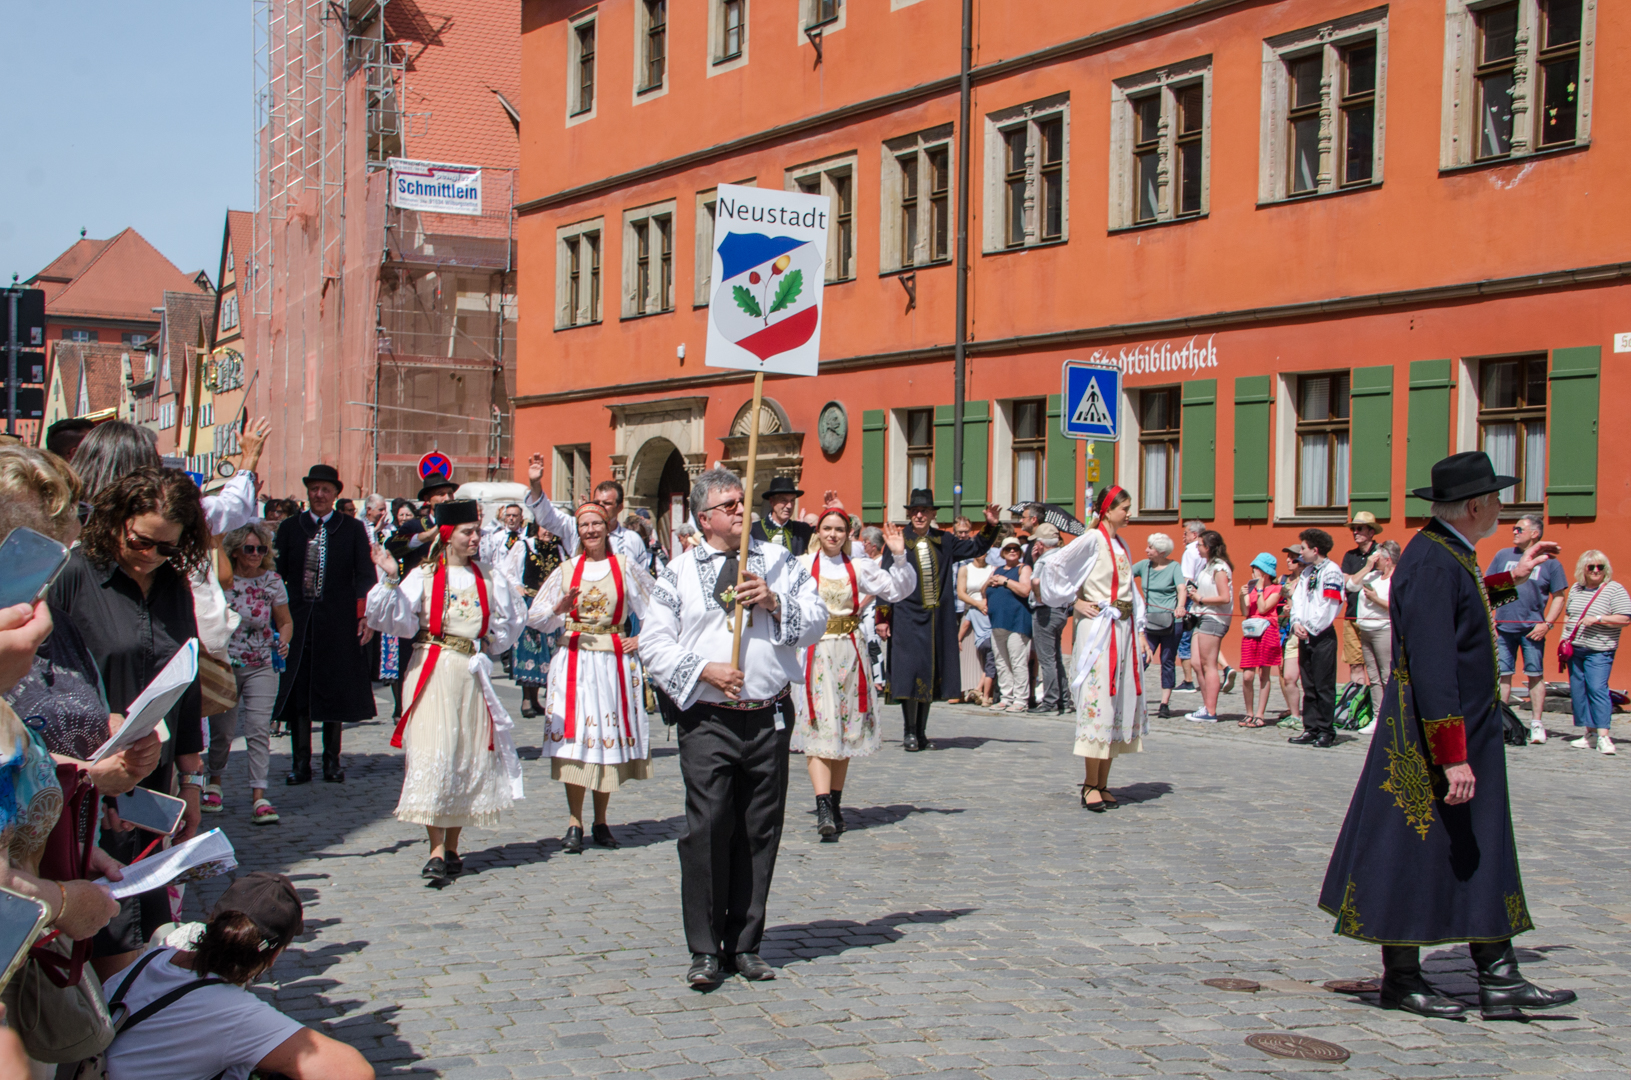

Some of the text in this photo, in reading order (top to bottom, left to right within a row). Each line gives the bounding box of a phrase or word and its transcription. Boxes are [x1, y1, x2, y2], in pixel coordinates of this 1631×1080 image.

[398, 179, 478, 200] Schmittlein
[719, 197, 826, 229] Neustadt
[1090, 333, 1218, 376] Stadtbibliothek
